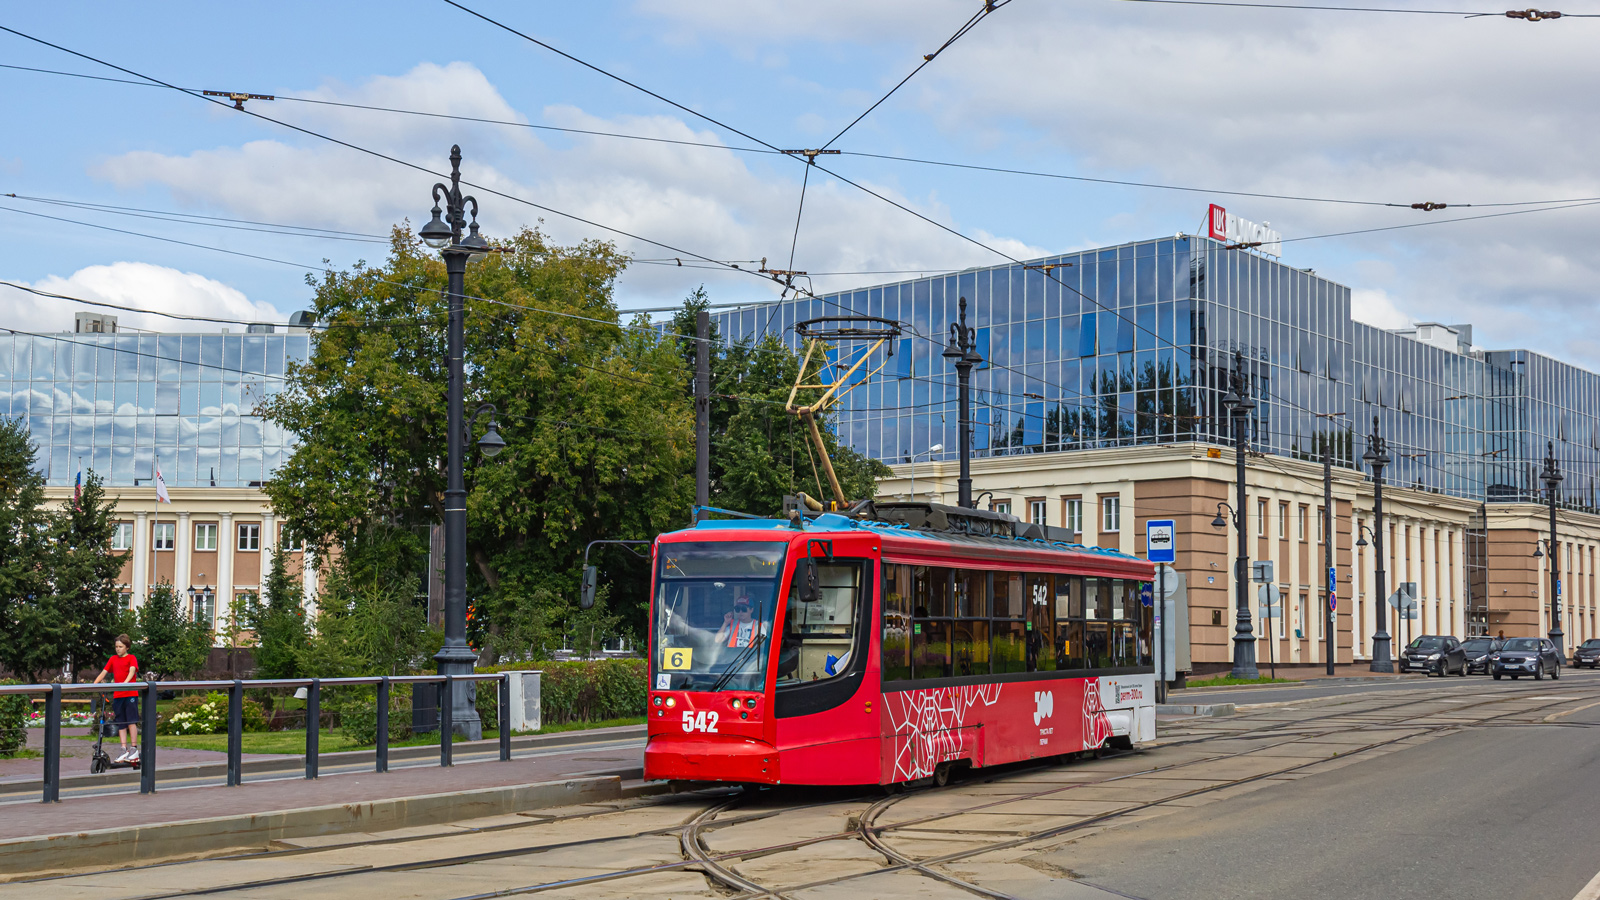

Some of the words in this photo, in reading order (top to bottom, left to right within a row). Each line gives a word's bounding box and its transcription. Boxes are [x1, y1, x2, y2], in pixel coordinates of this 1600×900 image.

[1033, 585, 1047, 605] 542
[670, 652, 683, 667] 6
[1120, 689, 1143, 703] perm-300.ru
[682, 710, 719, 733] 542
